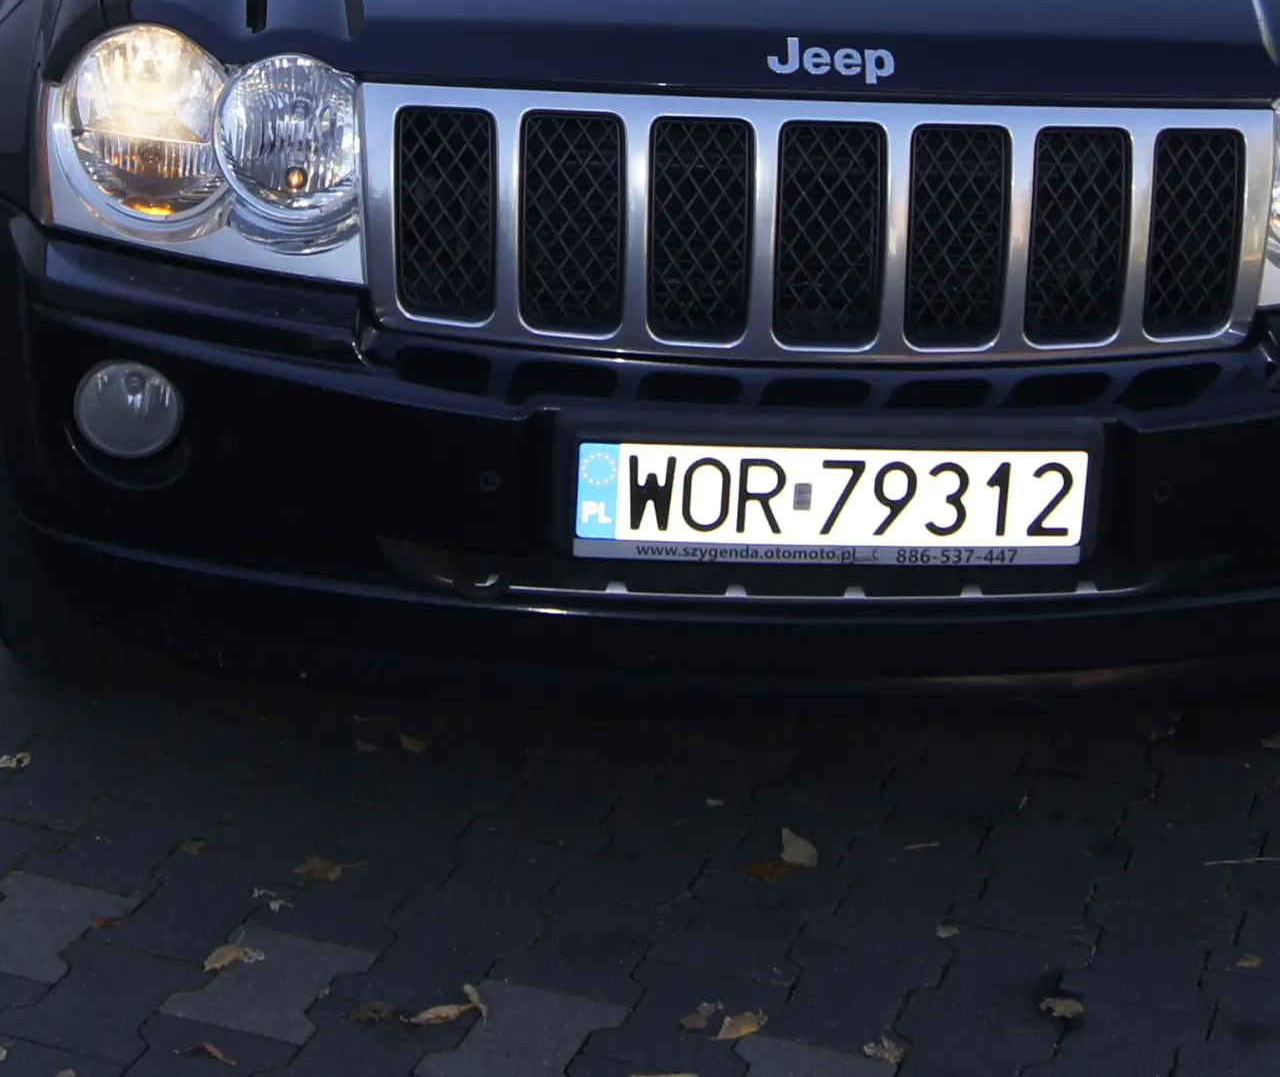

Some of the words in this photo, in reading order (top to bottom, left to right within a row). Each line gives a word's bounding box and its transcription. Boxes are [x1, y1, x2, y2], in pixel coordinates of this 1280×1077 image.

[767, 37, 895, 85] Jeep
[581, 500, 612, 524] PL
[629, 454, 787, 535] WOR
[819, 459, 1074, 537] 79312
[895, 548, 1019, 565] 886-537-447
